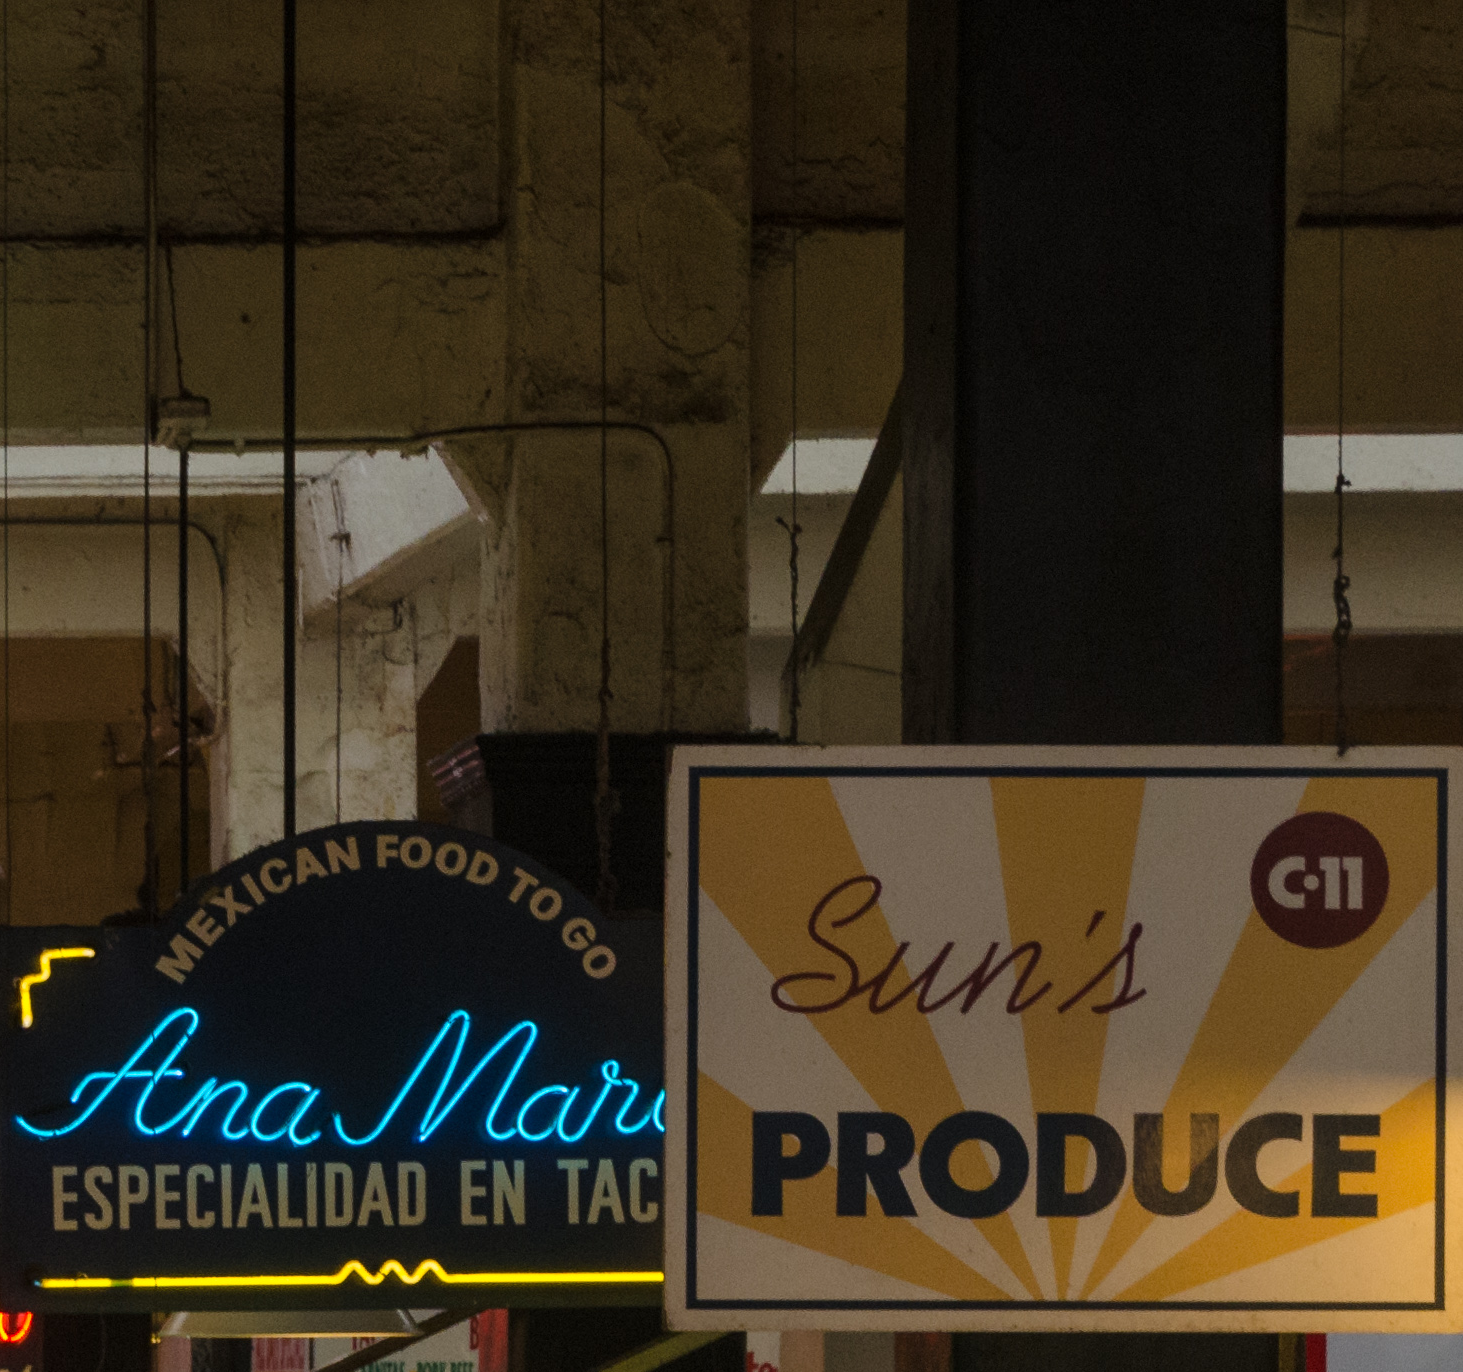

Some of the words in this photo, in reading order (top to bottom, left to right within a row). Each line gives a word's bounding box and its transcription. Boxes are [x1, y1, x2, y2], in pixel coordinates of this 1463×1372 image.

[154, 836, 362, 985] MEXICAN
[375, 834, 499, 887] FOOD
[508, 867, 564, 922] TO
[561, 916, 618, 980] GO
[770, 874, 1147, 1016] Sun's
[14, 1006, 322, 1146] Ana
[51, 1161, 428, 1231] ESPECIALIDAD
[459, 1159, 527, 1226] EN
[750, 1109, 1382, 1219] PRODUCE
